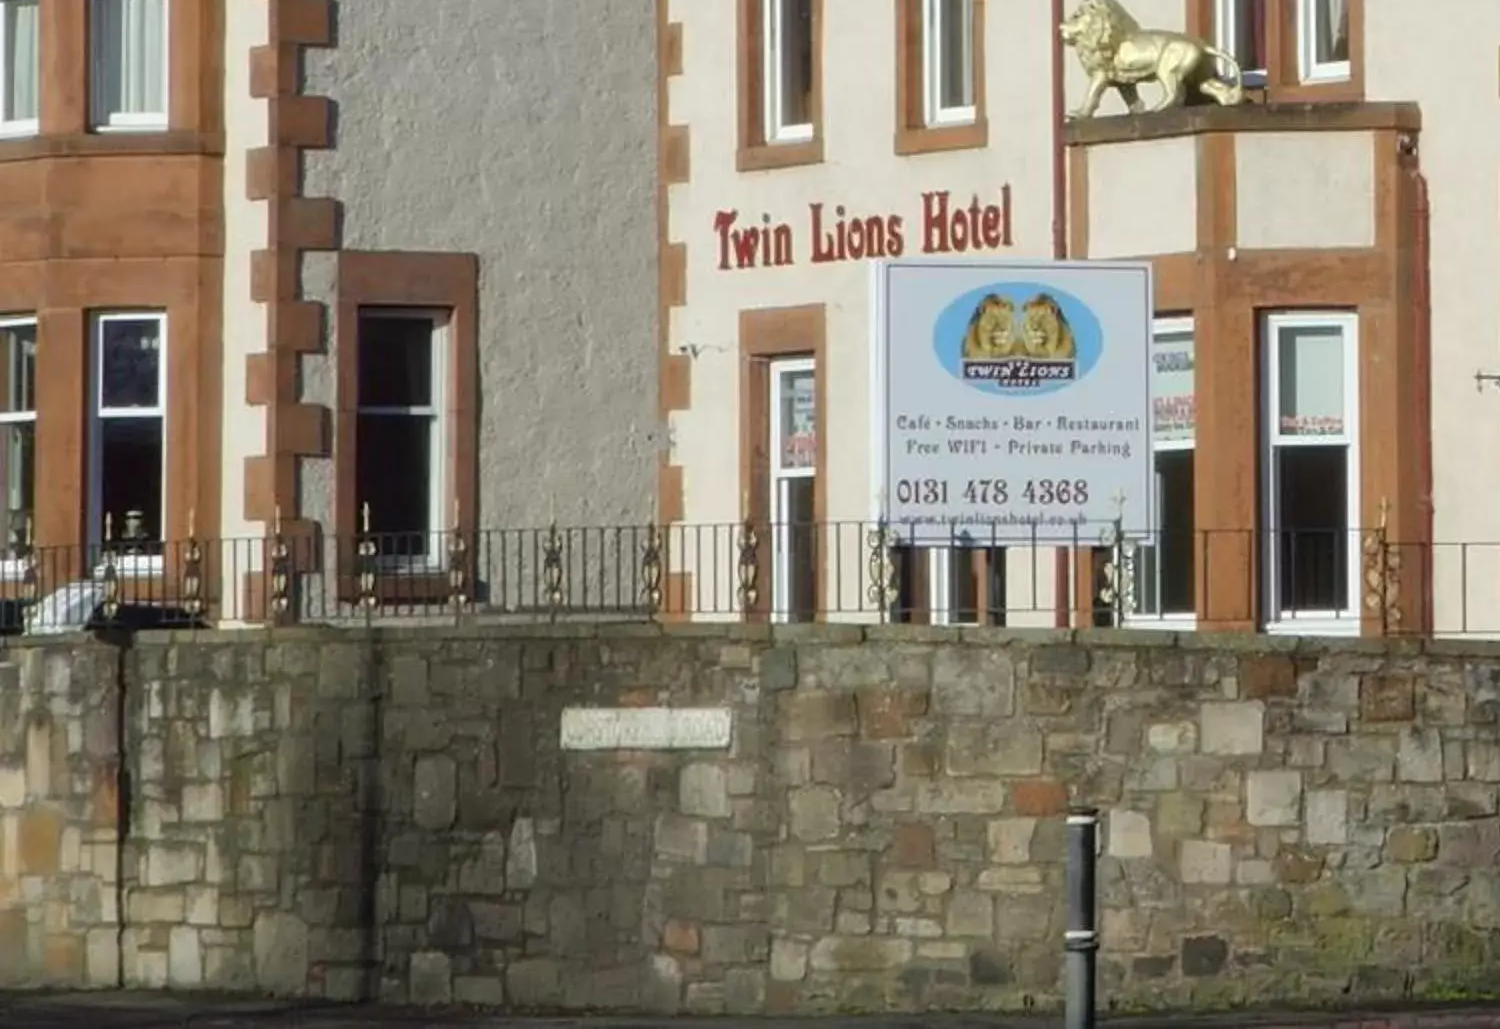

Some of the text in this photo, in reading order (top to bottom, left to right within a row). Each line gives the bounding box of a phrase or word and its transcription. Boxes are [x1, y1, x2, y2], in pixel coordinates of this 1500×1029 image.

[714, 181, 1014, 270] Twin Lions Hotel
[896, 415, 931, 431] Café
[1012, 416, 1041, 431] Bar
[1056, 415, 1140, 431] Restaurant
[906, 439, 940, 455] Free
[1008, 439, 1063, 455] Private
[1070, 439, 1132, 457] Parking
[897, 478, 1089, 505] 0131 478 4368
